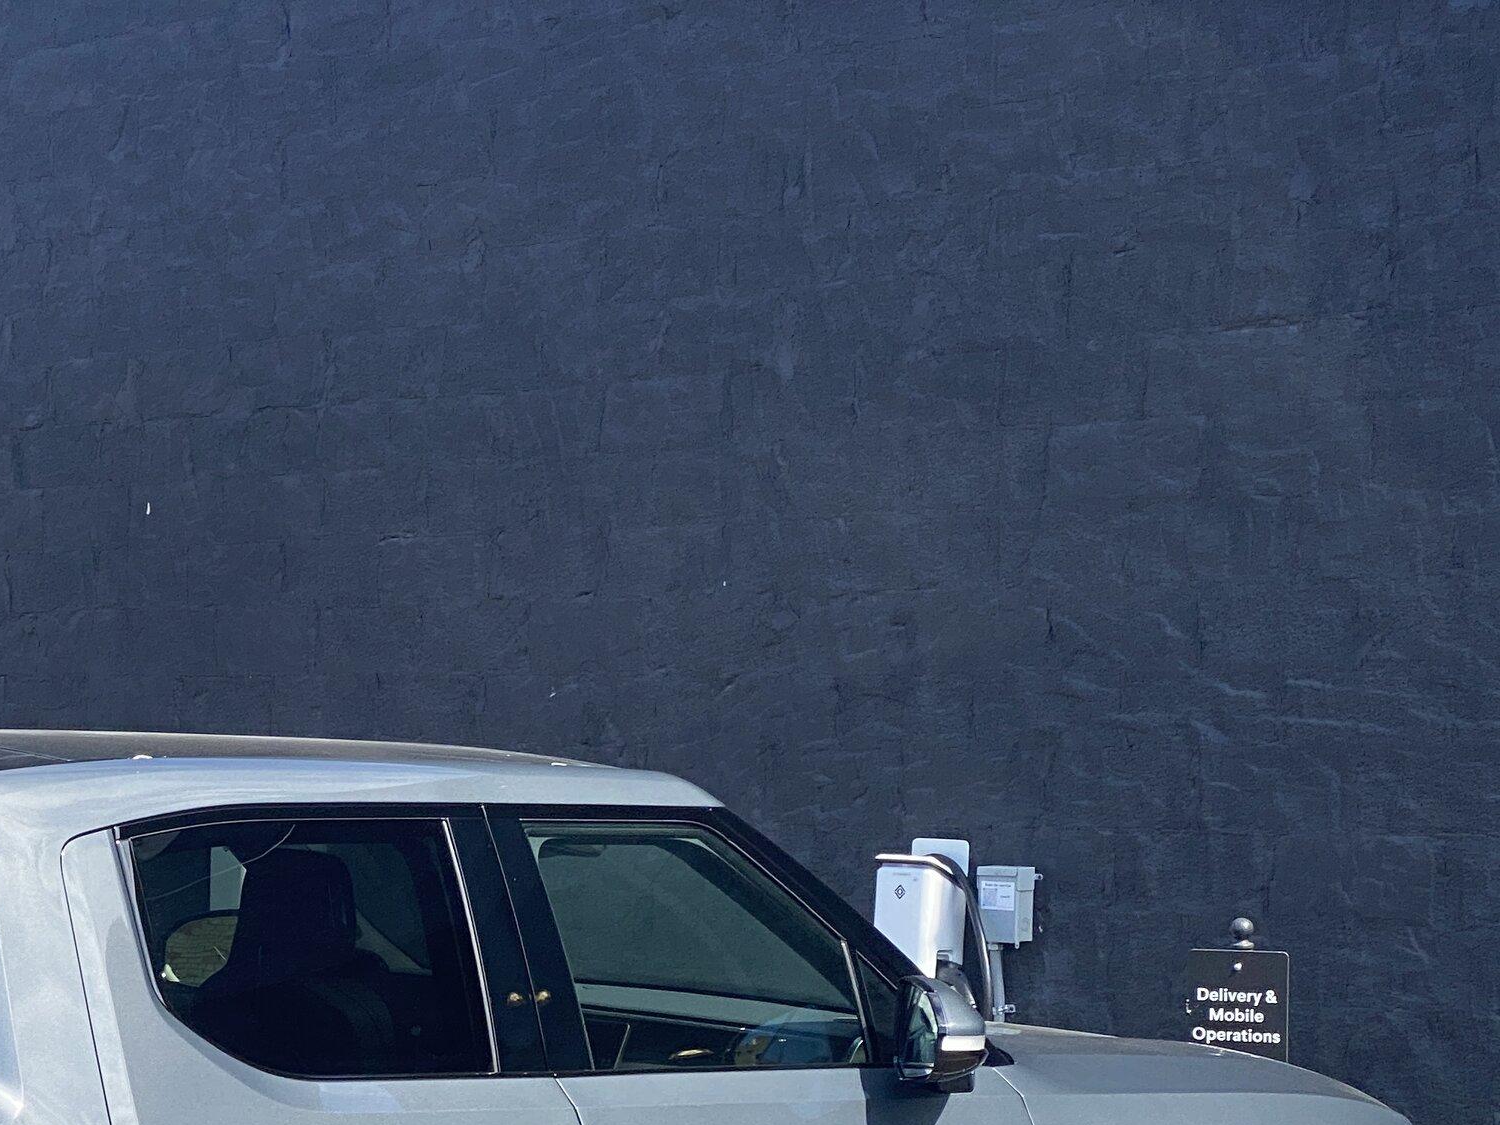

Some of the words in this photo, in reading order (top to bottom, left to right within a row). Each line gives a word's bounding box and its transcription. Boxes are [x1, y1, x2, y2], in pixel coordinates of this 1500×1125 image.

[1196, 987, 1262, 1007] Delivery
[1265, 989, 1278, 1004] &
[1209, 1007, 1265, 1023] Mobile
[1192, 1026, 1281, 1044] Operations
